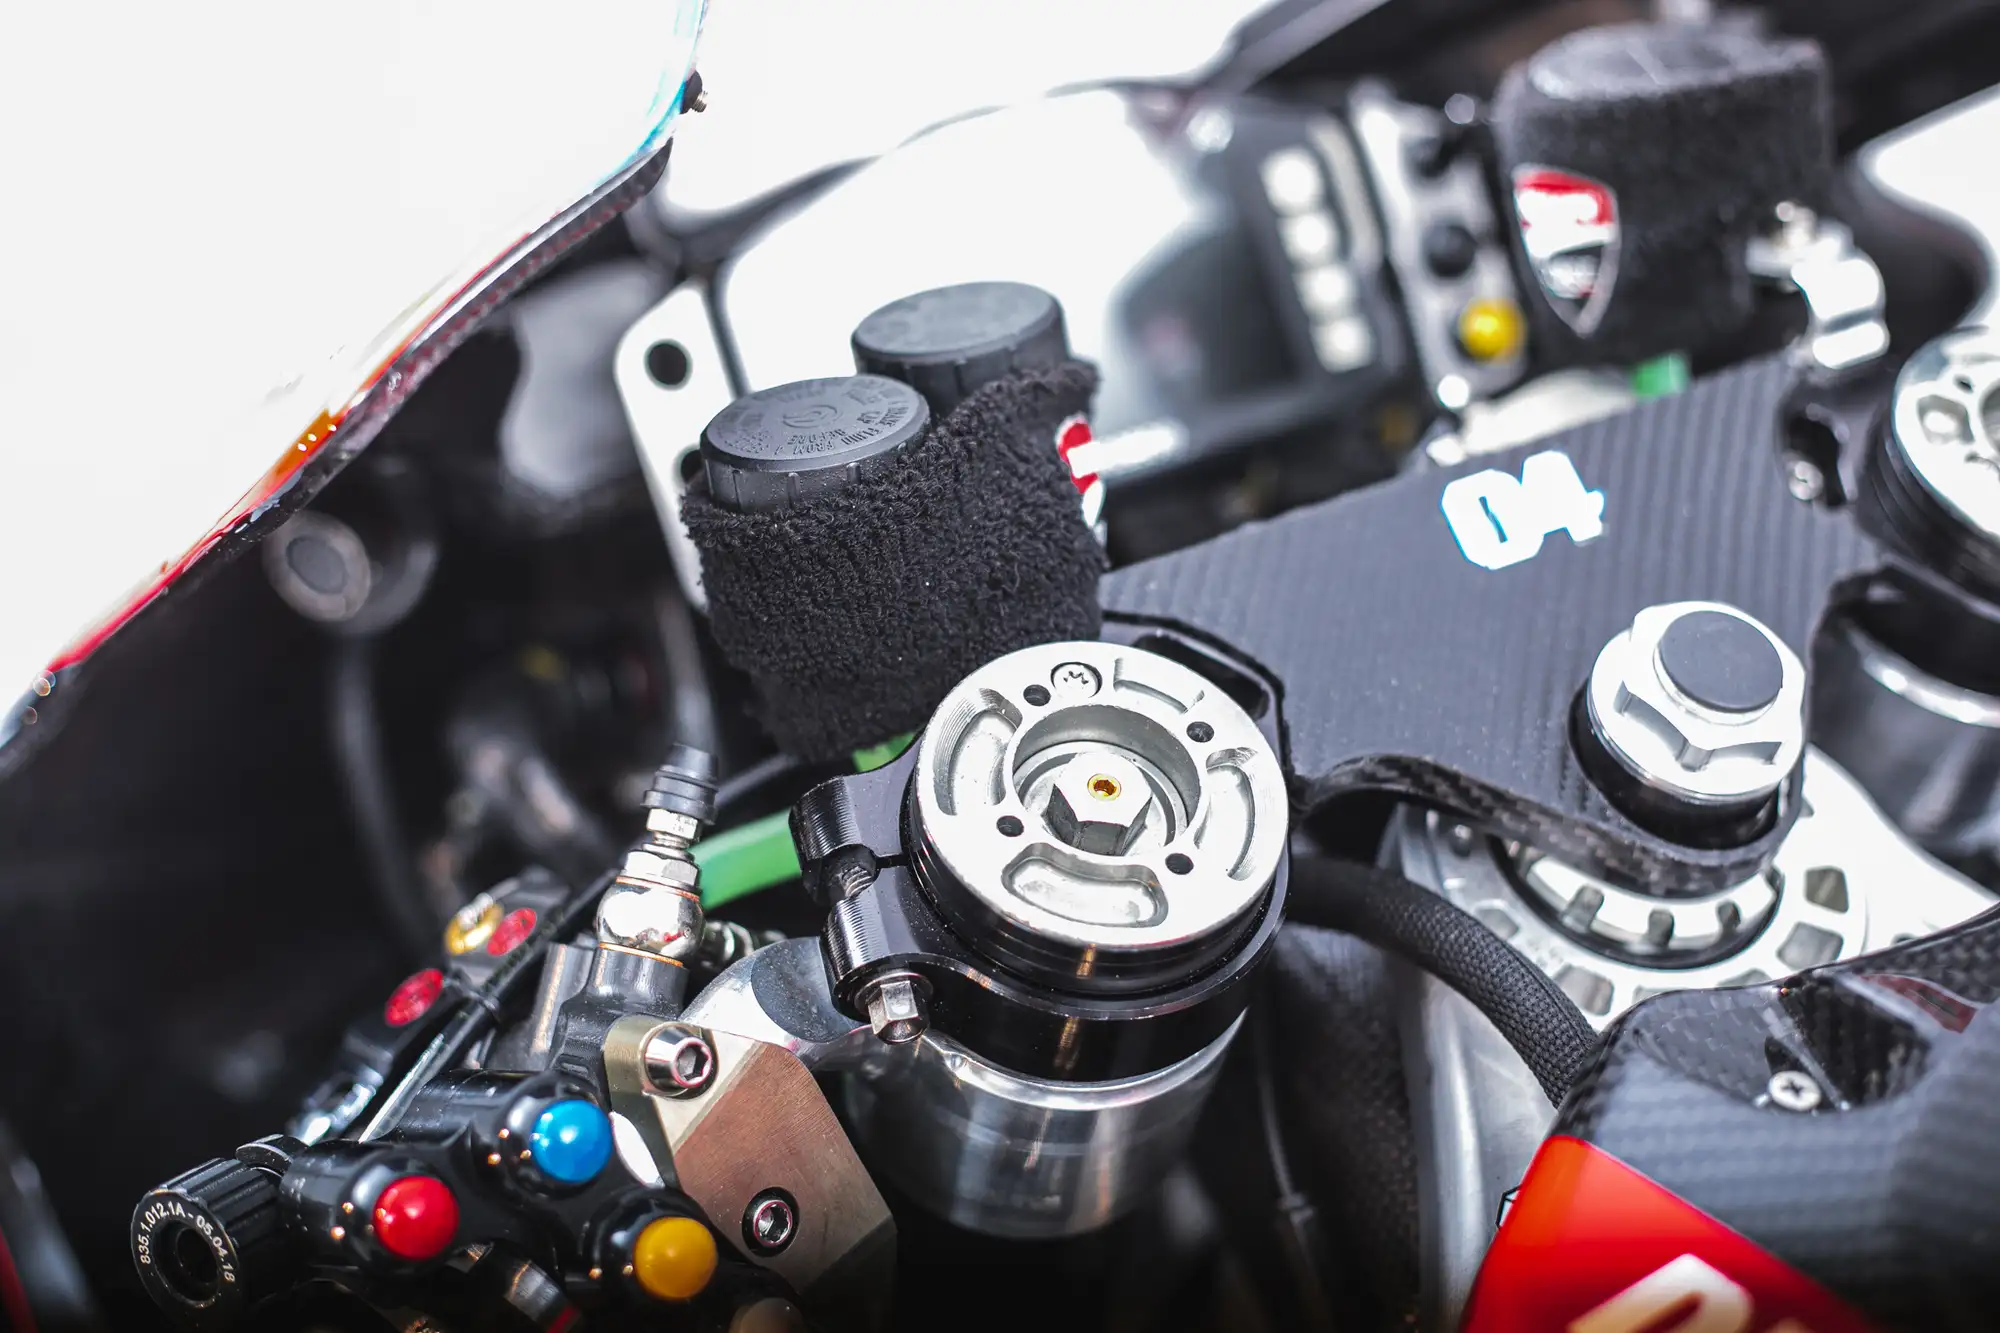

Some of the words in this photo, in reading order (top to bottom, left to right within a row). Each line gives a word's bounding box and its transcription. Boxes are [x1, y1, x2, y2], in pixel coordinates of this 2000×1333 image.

[787, 428, 847, 445] BEFORE
[792, 439, 834, 455] FROM
[1440, 451, 1605, 571] 04
